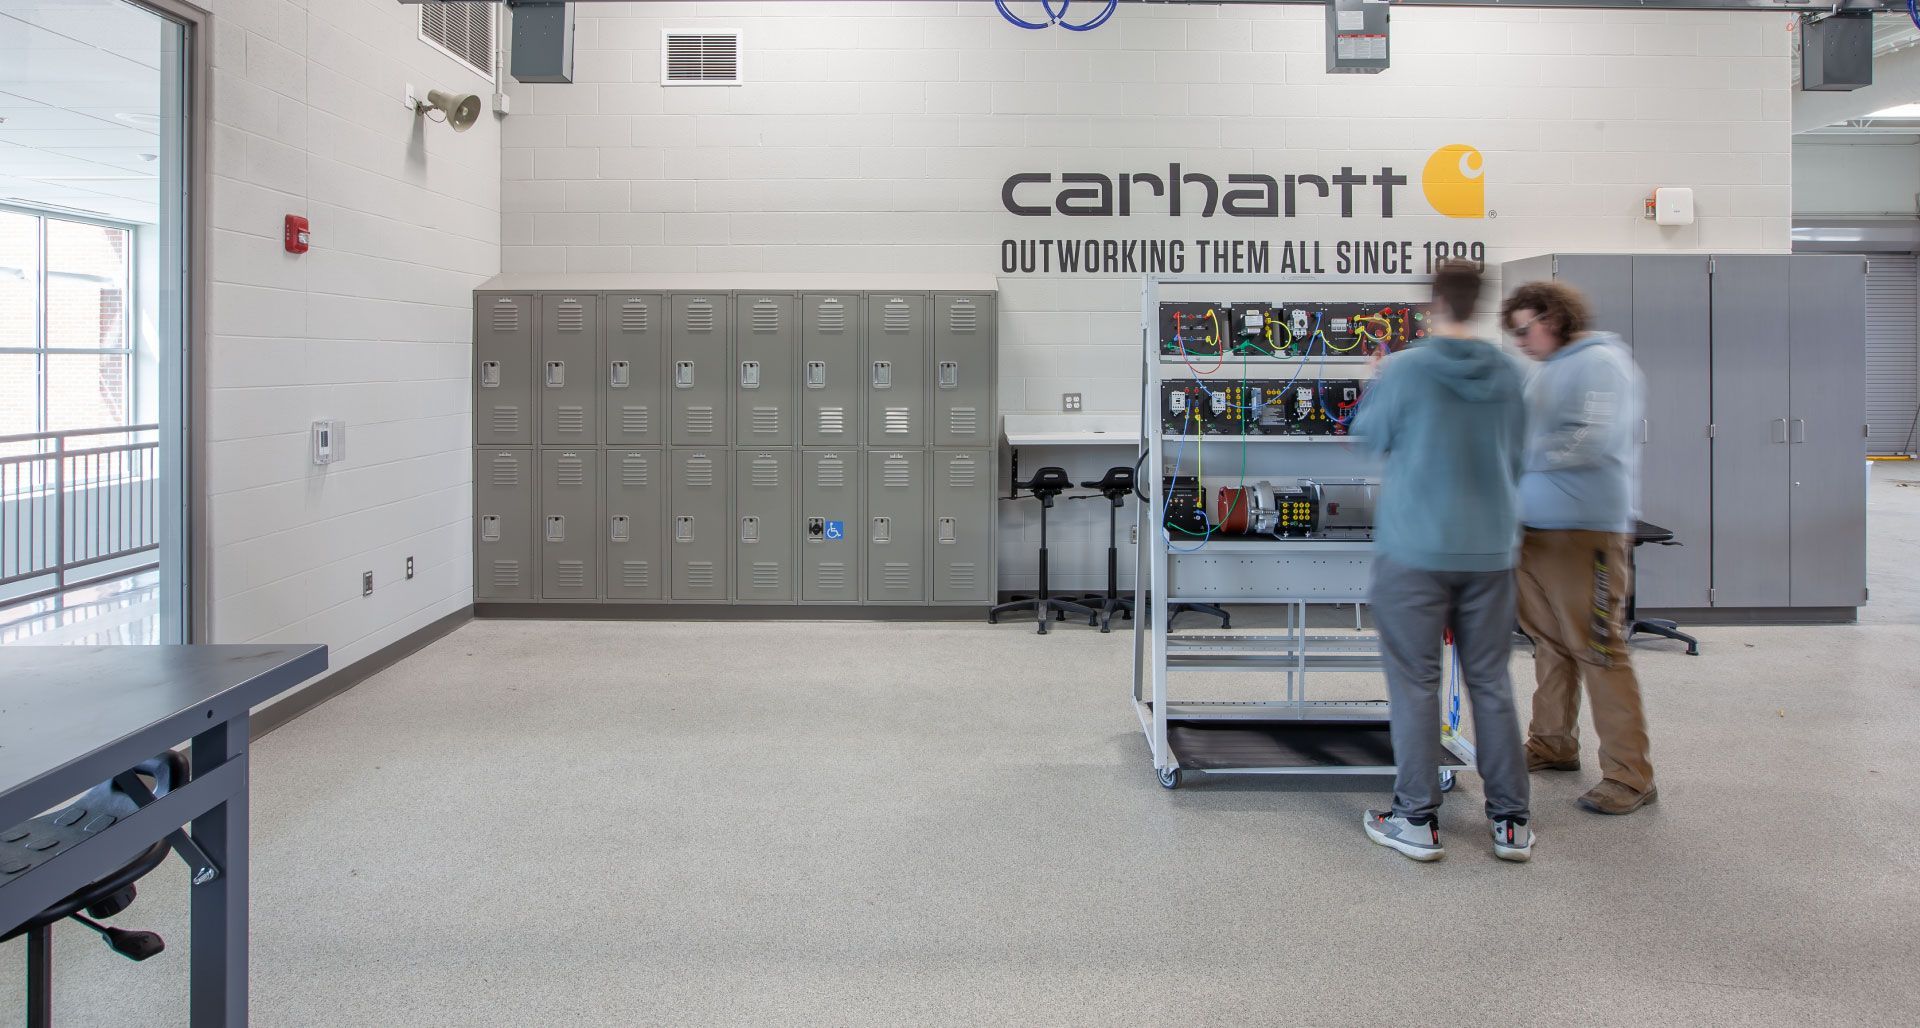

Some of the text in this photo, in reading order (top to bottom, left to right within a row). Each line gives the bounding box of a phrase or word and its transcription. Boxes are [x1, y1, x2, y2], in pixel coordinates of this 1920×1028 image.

[1002, 162, 1407, 218] carhartt
[1001, 239, 1185, 274] OUTWORKING
[1195, 240, 1269, 274] THEM
[1280, 240, 1325, 274] ALL
[1336, 240, 1413, 274] SINCE
